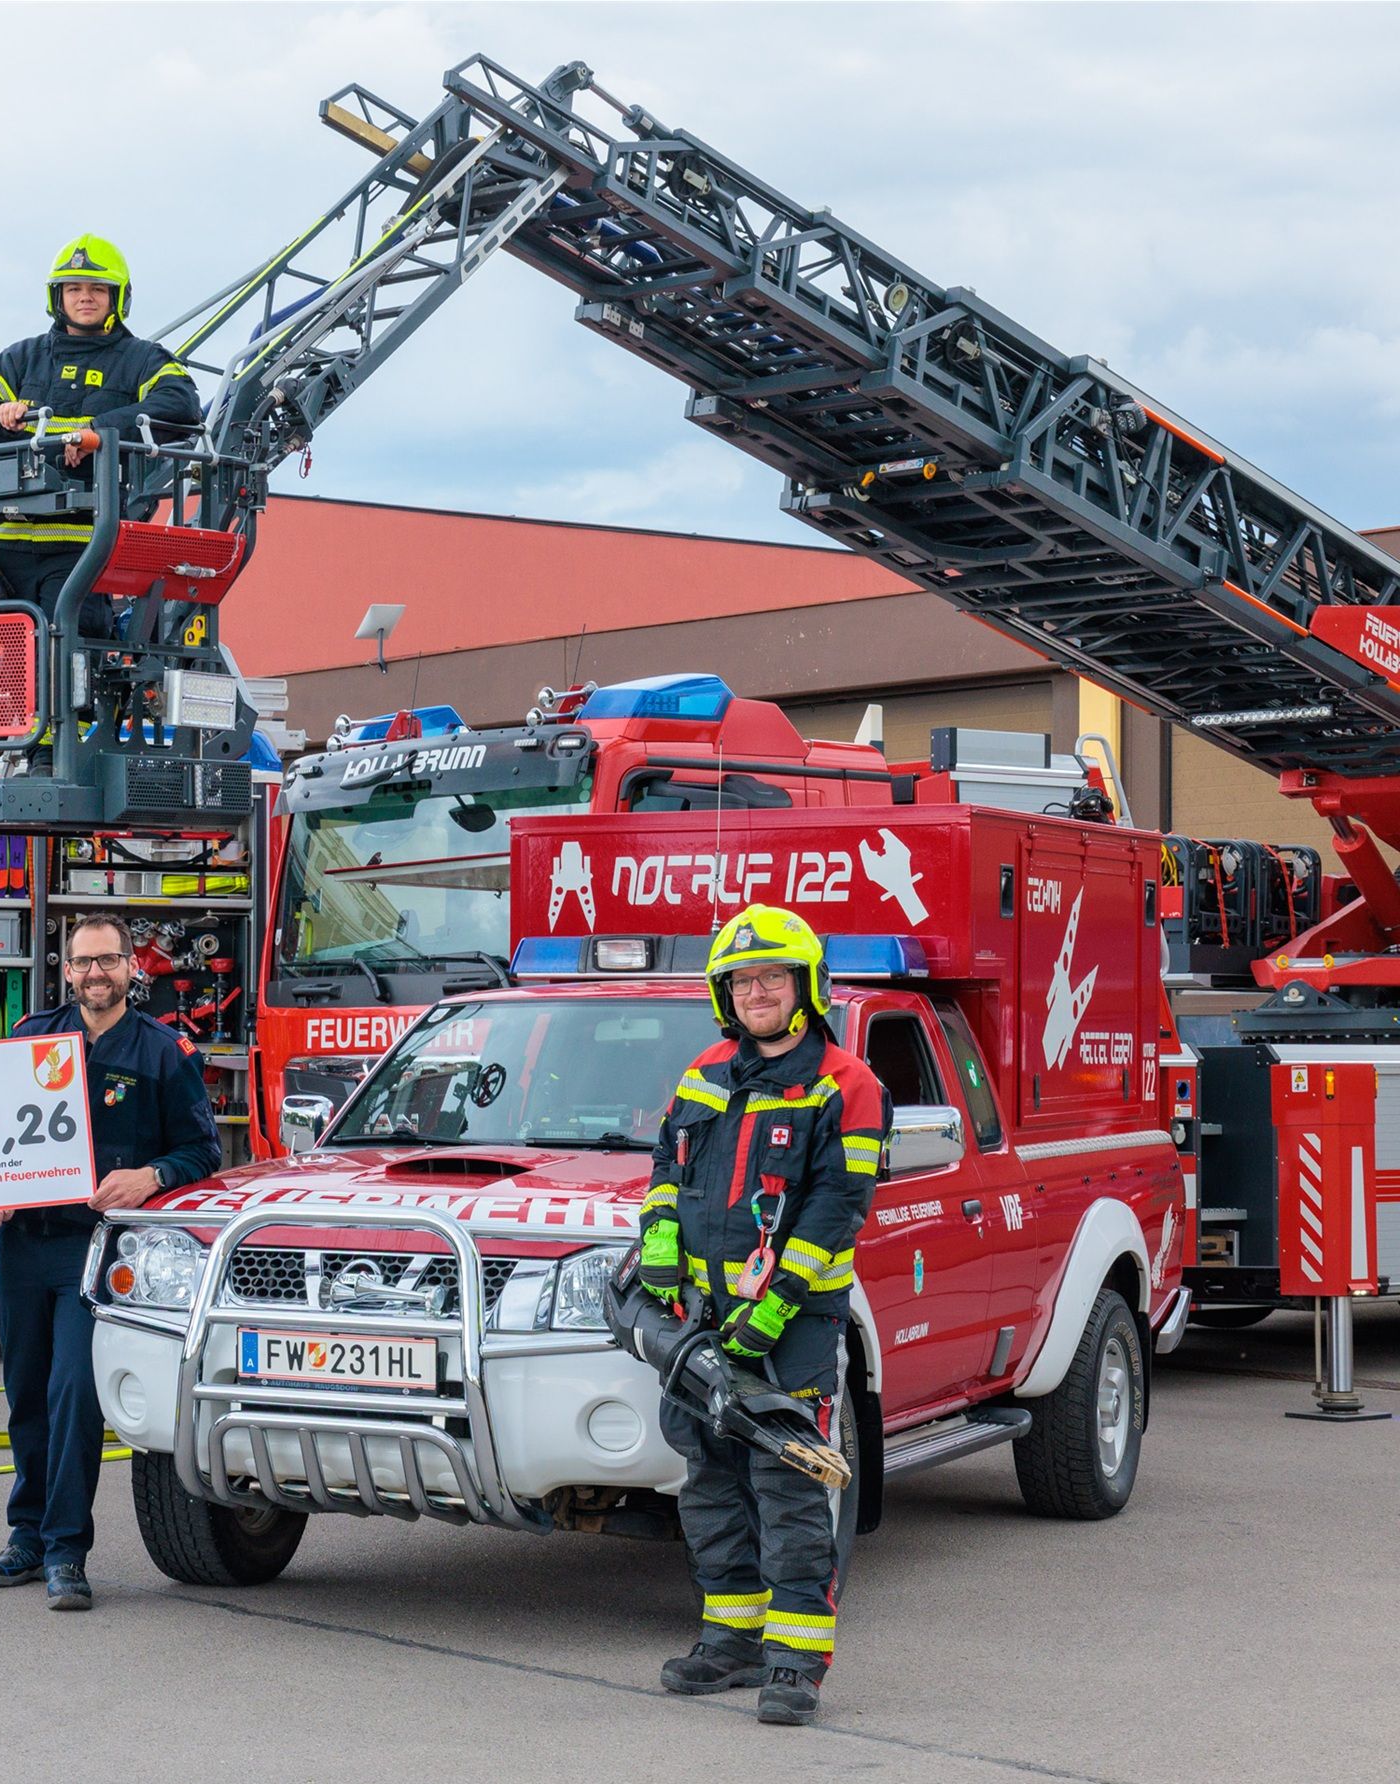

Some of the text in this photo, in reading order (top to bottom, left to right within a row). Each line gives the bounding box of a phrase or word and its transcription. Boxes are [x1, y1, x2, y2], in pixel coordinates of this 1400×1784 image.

[1364, 612, 1400, 650] FEUER
[1359, 633, 1400, 674] HOLLAB
[611, 851, 852, 905] NOTRUF 122
[11, 980, 19, 992] C
[4, 1165, 81, 1183] Feuerwehren
[7, 1158, 23, 1169] der
[876, 1200, 944, 1227] FREIWILLIGE FEUERWEHR
[999, 1193, 1024, 1231] VRF
[894, 1322, 929, 1345] HOLLABRUNN
[246, 1358, 254, 1368] A
[267, 1339, 306, 1372] FW
